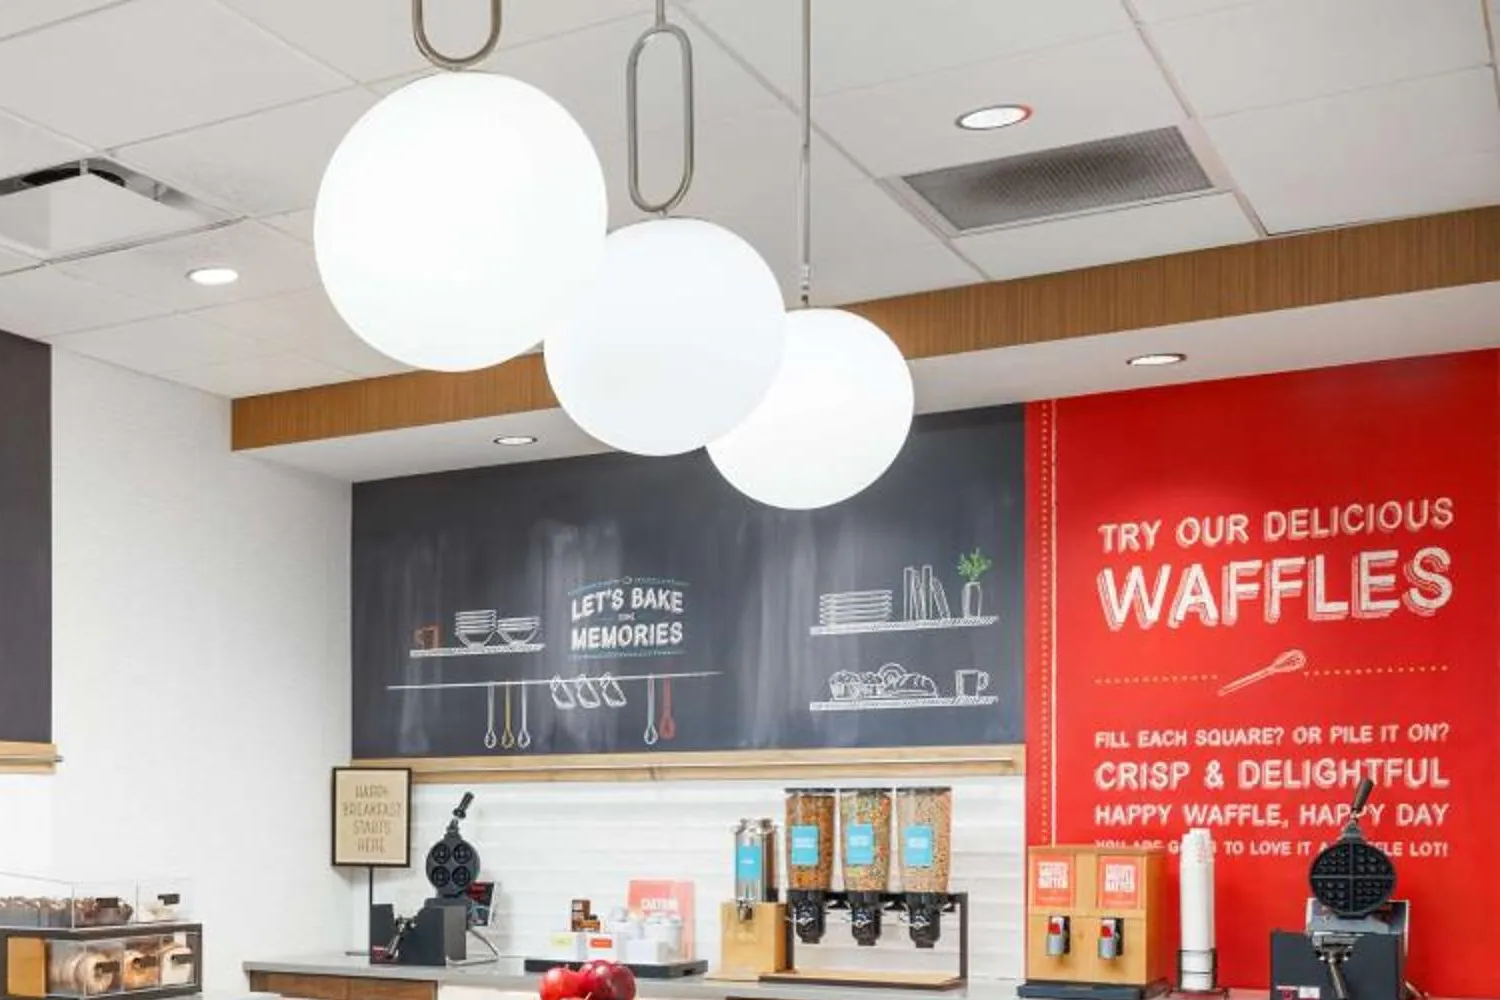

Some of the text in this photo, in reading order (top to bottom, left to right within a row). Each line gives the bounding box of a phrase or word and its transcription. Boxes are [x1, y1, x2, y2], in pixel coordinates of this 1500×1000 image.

[1098, 497, 1453, 553] TRY OUR DELICIOUS
[571, 587, 684, 622] LET'S BAKE
[1096, 547, 1453, 632] WAFFLES
[571, 621, 683, 651] MEMORIES
[1094, 722, 1450, 748] FILL EACH SQUARE? OR PILE IT ON?
[1094, 757, 1450, 791] CRISP & DELIGHTFUL
[1094, 803, 1172, 827] HAPPY
[1183, 803, 1289, 828] WAFFLE,
[1395, 803, 1449, 827] DAY
[1223, 840, 1244, 855] TO
[1250, 841, 1291, 855] LOVE
[1297, 841, 1312, 856] IT
[1409, 841, 1448, 857] LOT!
